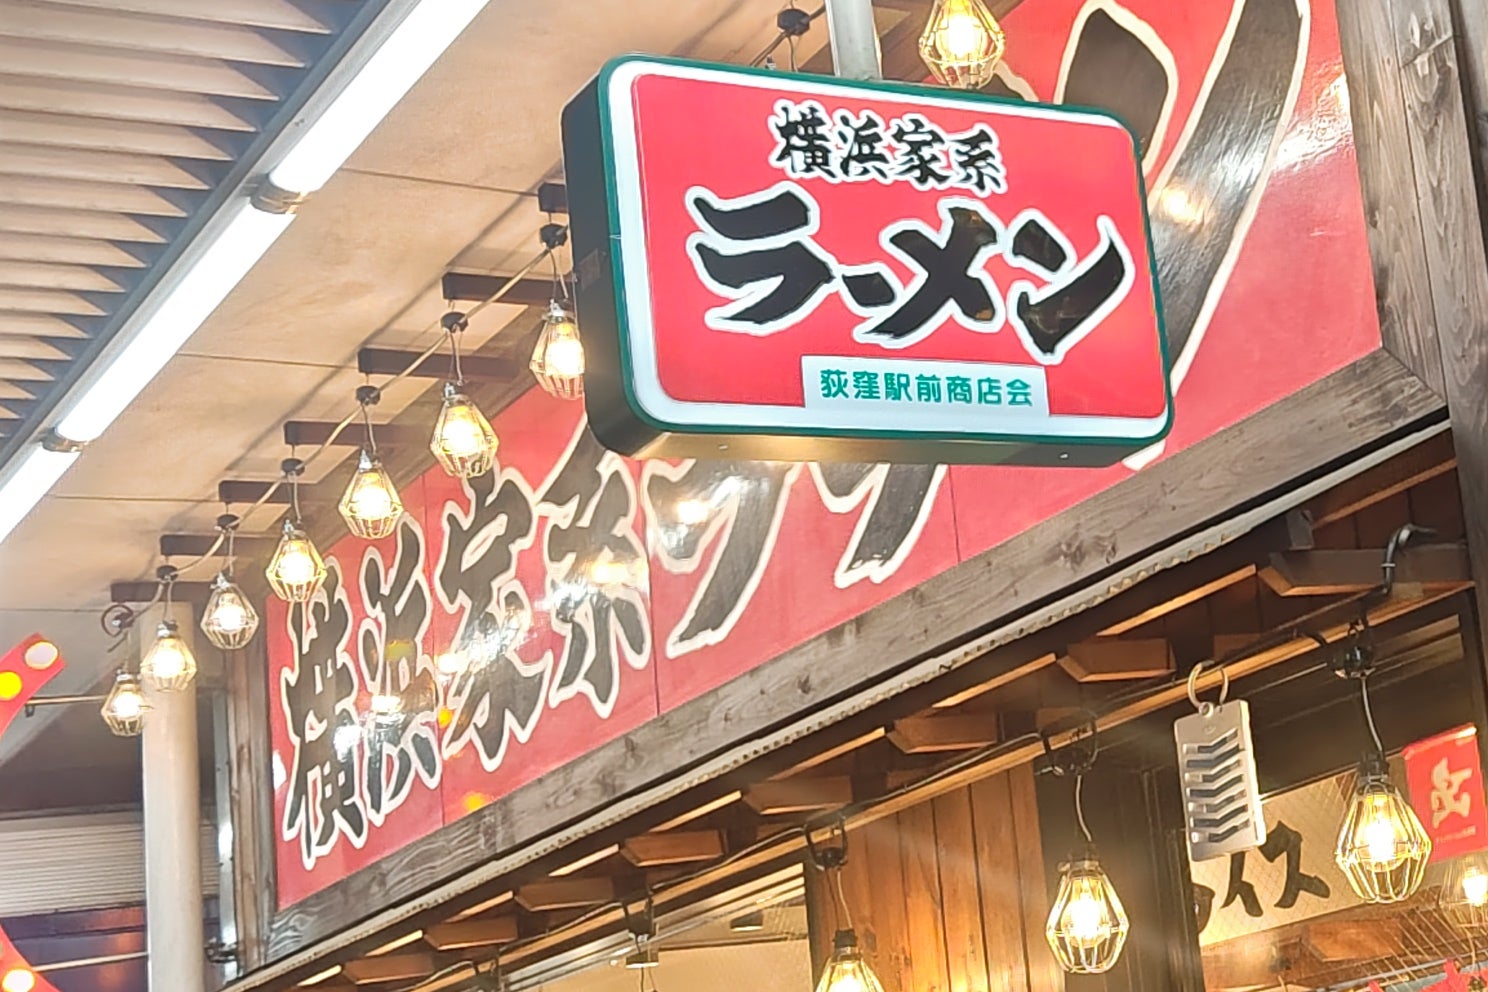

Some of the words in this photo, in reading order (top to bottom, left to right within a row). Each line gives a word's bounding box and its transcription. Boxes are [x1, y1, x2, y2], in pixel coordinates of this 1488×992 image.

[777, 104, 1005, 192] 横浜家系
[693, 189, 1127, 355] ラーメン
[820, 368, 1033, 407] 荻窪駅前商店会
[1193, 820, 1332, 933] イス
